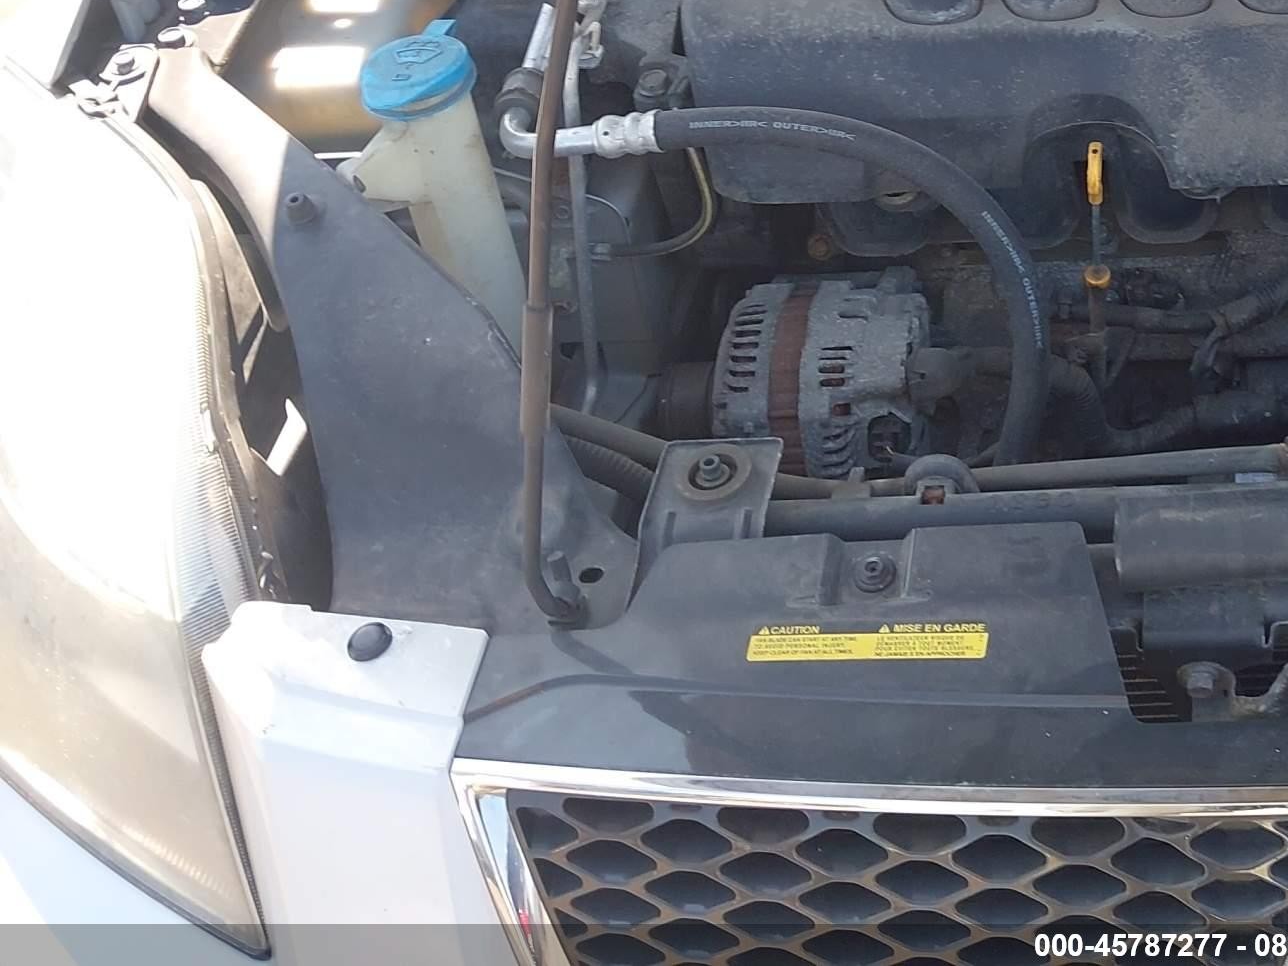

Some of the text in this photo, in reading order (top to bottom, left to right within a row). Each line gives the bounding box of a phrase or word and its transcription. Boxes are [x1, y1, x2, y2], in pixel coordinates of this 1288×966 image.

[771, 626, 820, 635] CAUTION
[893, 623, 986, 632] MISE EN GARDE
